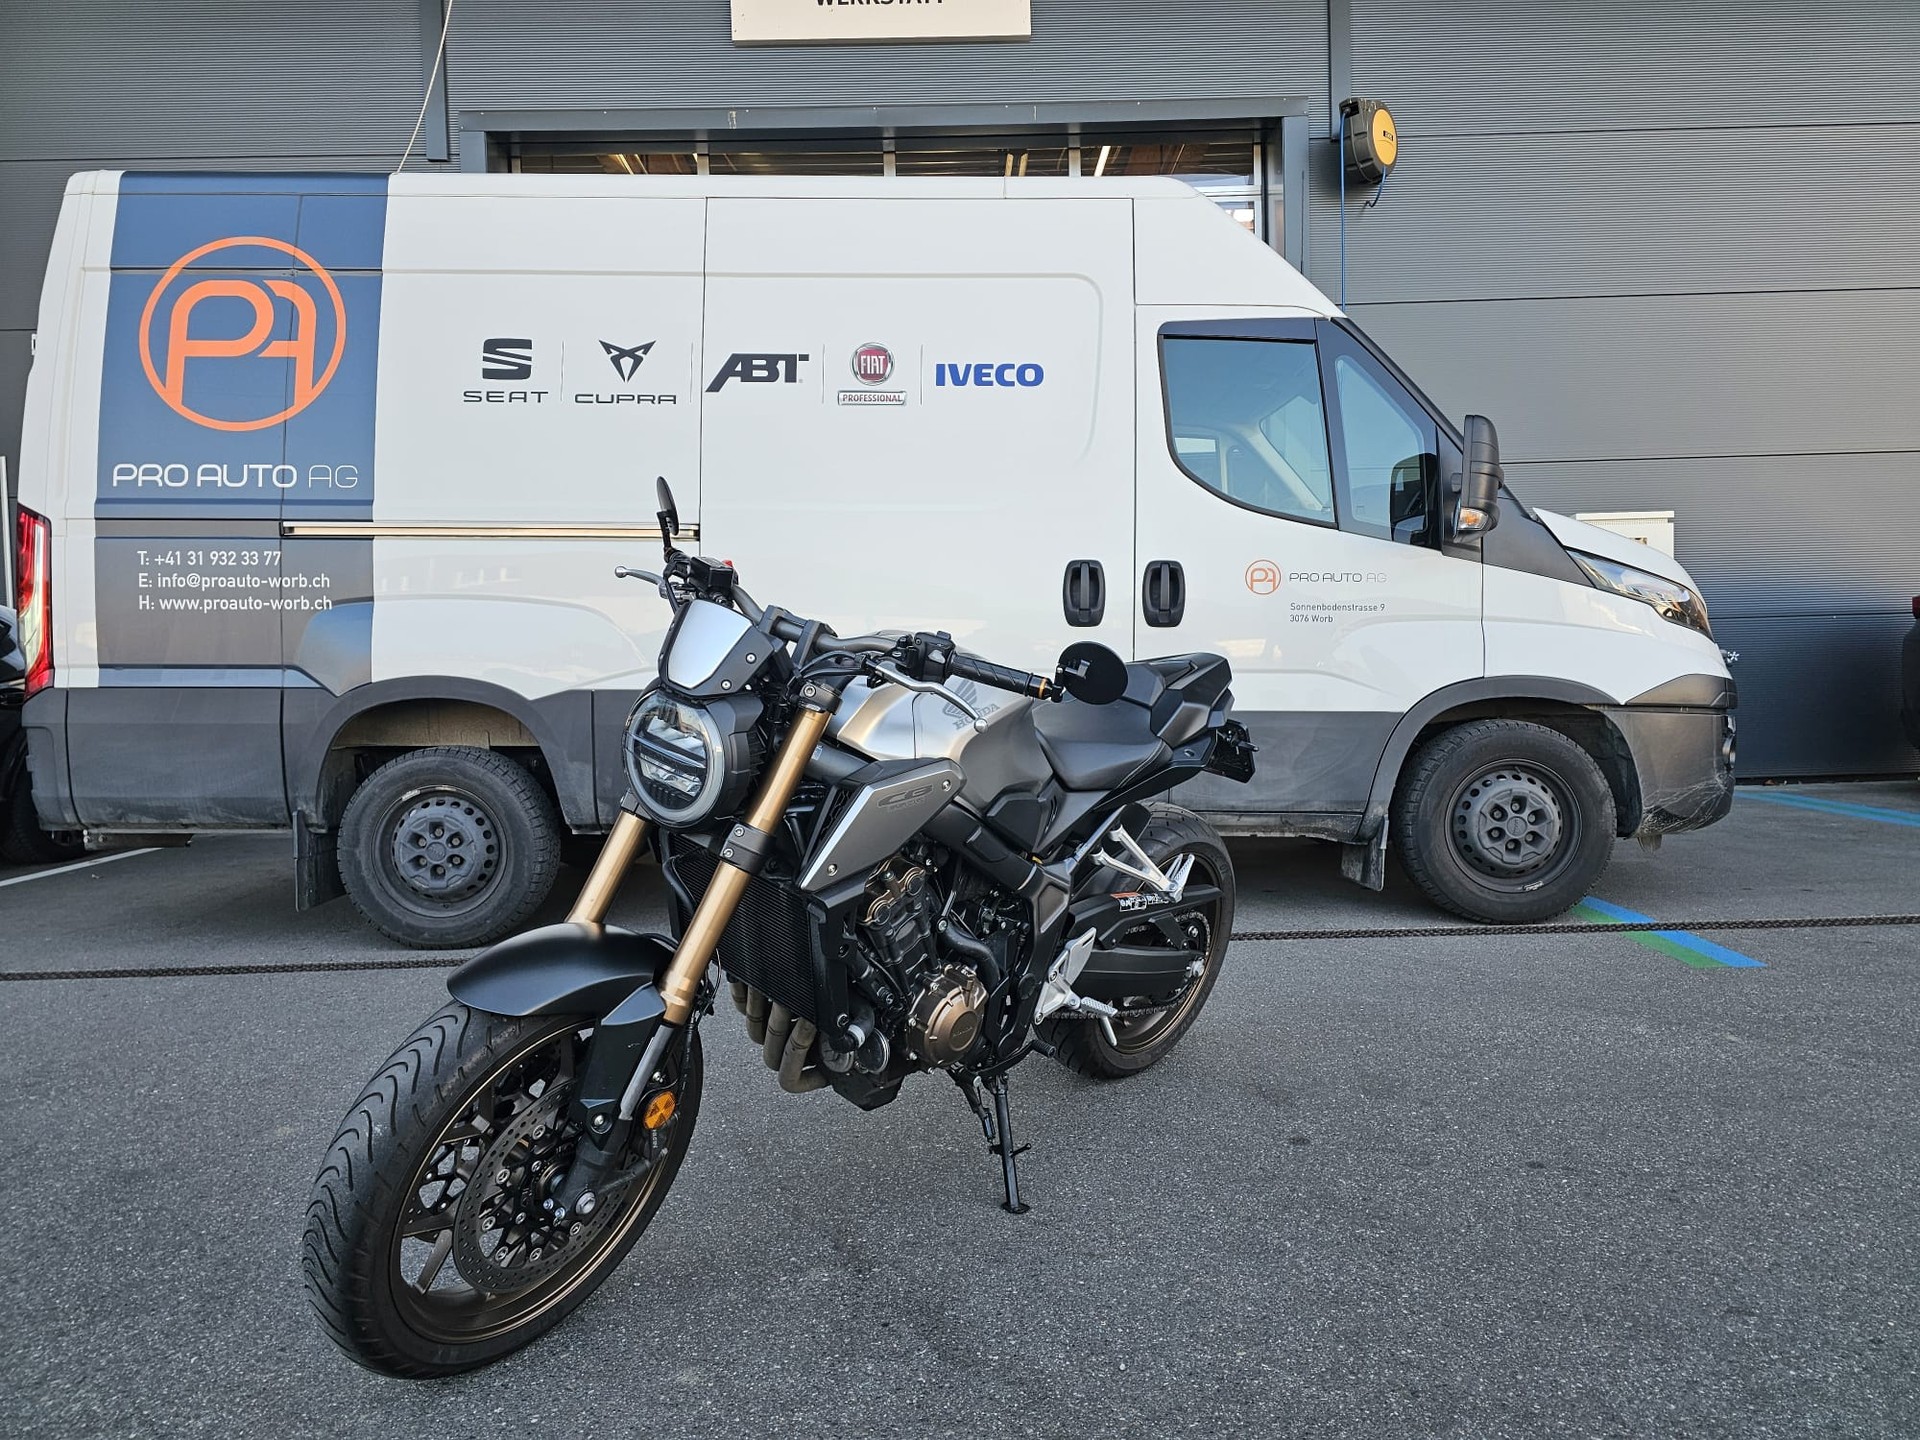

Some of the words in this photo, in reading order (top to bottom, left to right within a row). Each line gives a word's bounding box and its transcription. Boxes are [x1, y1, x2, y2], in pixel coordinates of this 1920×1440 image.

[704, 352, 810, 393] ABT
[860, 355, 886, 375] FIAT
[936, 363, 1045, 388] IVECO
[463, 391, 548, 404] SEAT
[575, 393, 677, 405] CUPRA
[842, 394, 904, 403] PROFESSIONAL
[112, 464, 189, 487] PRO
[196, 464, 298, 488] AUTO
[308, 465, 359, 488] AG
[137, 551, 150, 566] T:
[154, 551, 181, 566] +41
[187, 551, 202, 566] 31
[210, 551, 237, 566] 932
[241, 551, 259, 566] 33
[263, 551, 281, 566] 77
[138, 574, 152, 588] E:
[157, 573, 330, 592] info@proauto-worb.ch
[1289, 572, 1320, 583] PRO
[1322, 572, 1362, 583] AUTO
[1366, 572, 1388, 583] AG
[139, 596, 155, 611] H:
[159, 595, 333, 614] www.proauto-worb.ch
[1290, 602, 1378, 612] Sonnenbodenstrasse
[1380, 603, 1386, 612] 9
[1289, 613, 1310, 623] 3076
[1311, 613, 1334, 623] Worb
